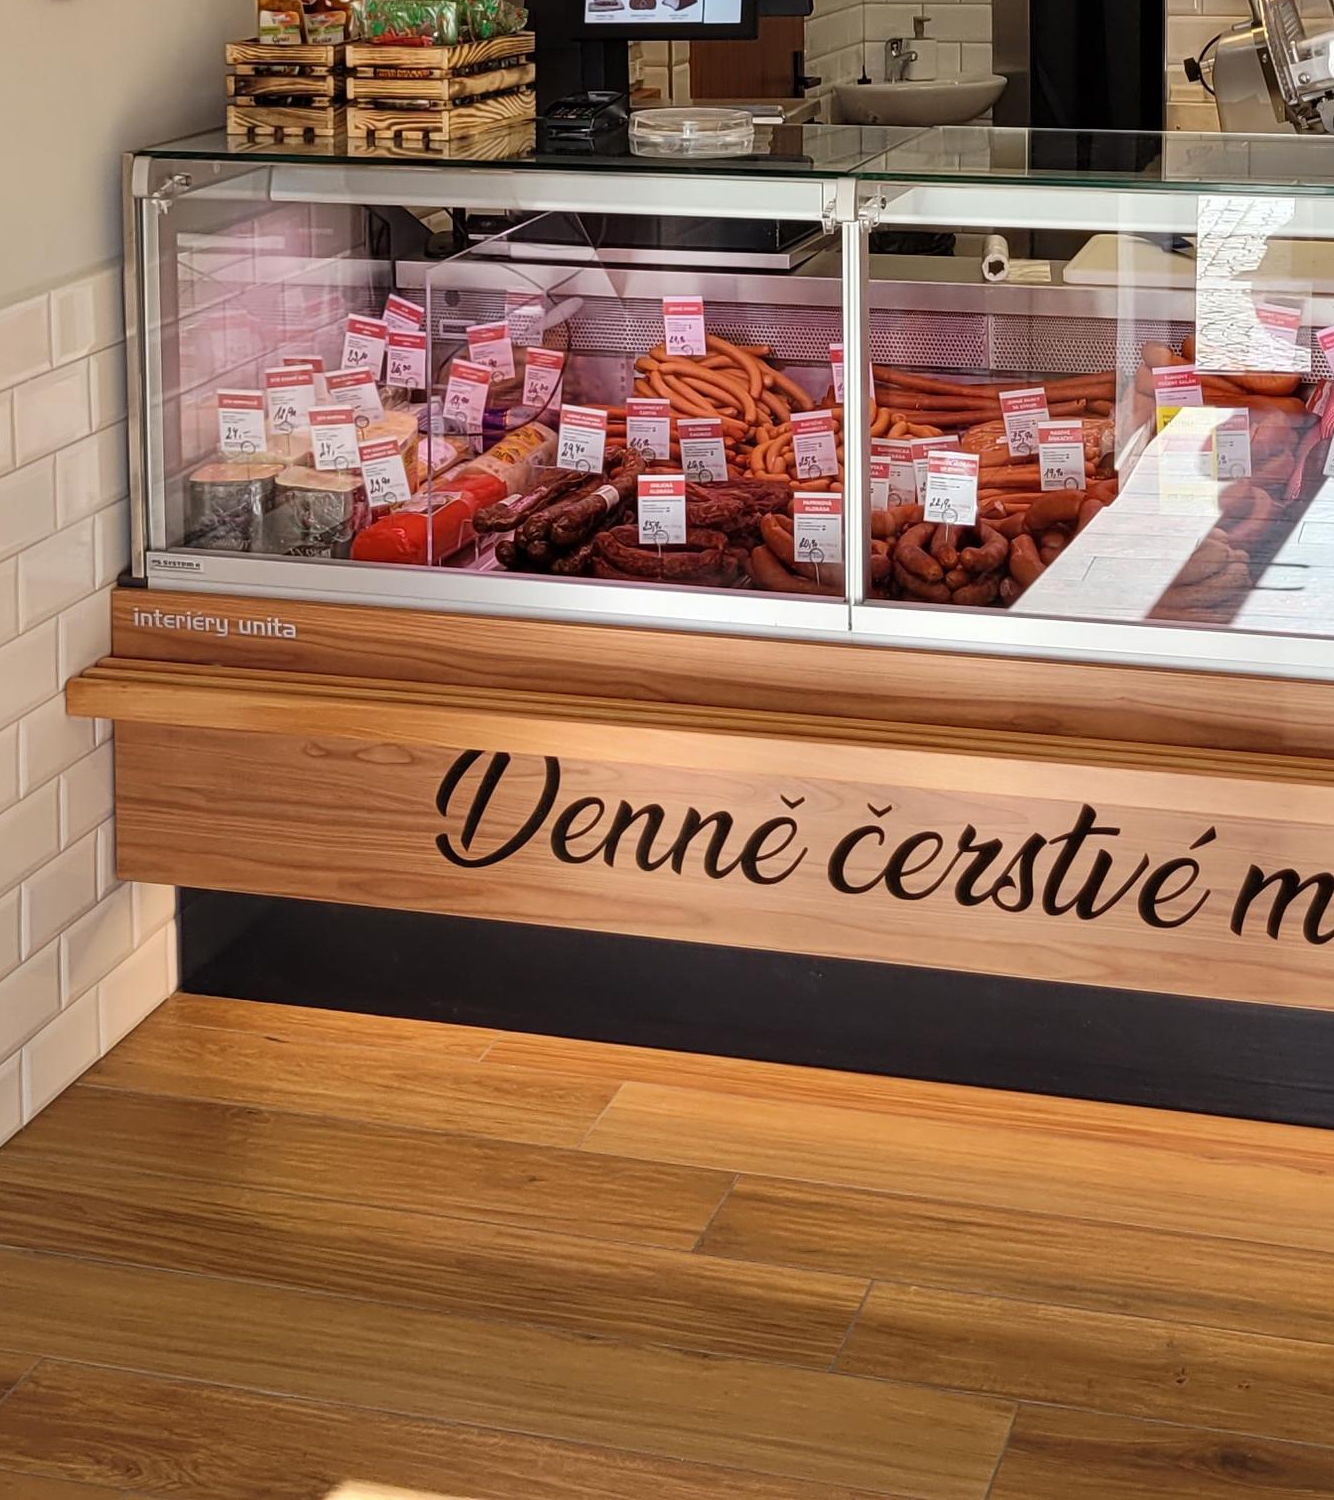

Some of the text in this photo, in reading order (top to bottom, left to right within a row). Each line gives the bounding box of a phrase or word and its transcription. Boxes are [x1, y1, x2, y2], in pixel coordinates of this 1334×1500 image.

[133, 607, 297, 639] interiéry unita
[436, 748, 807, 885] Denně
[826, 802, 1223, 927] čerstvé
